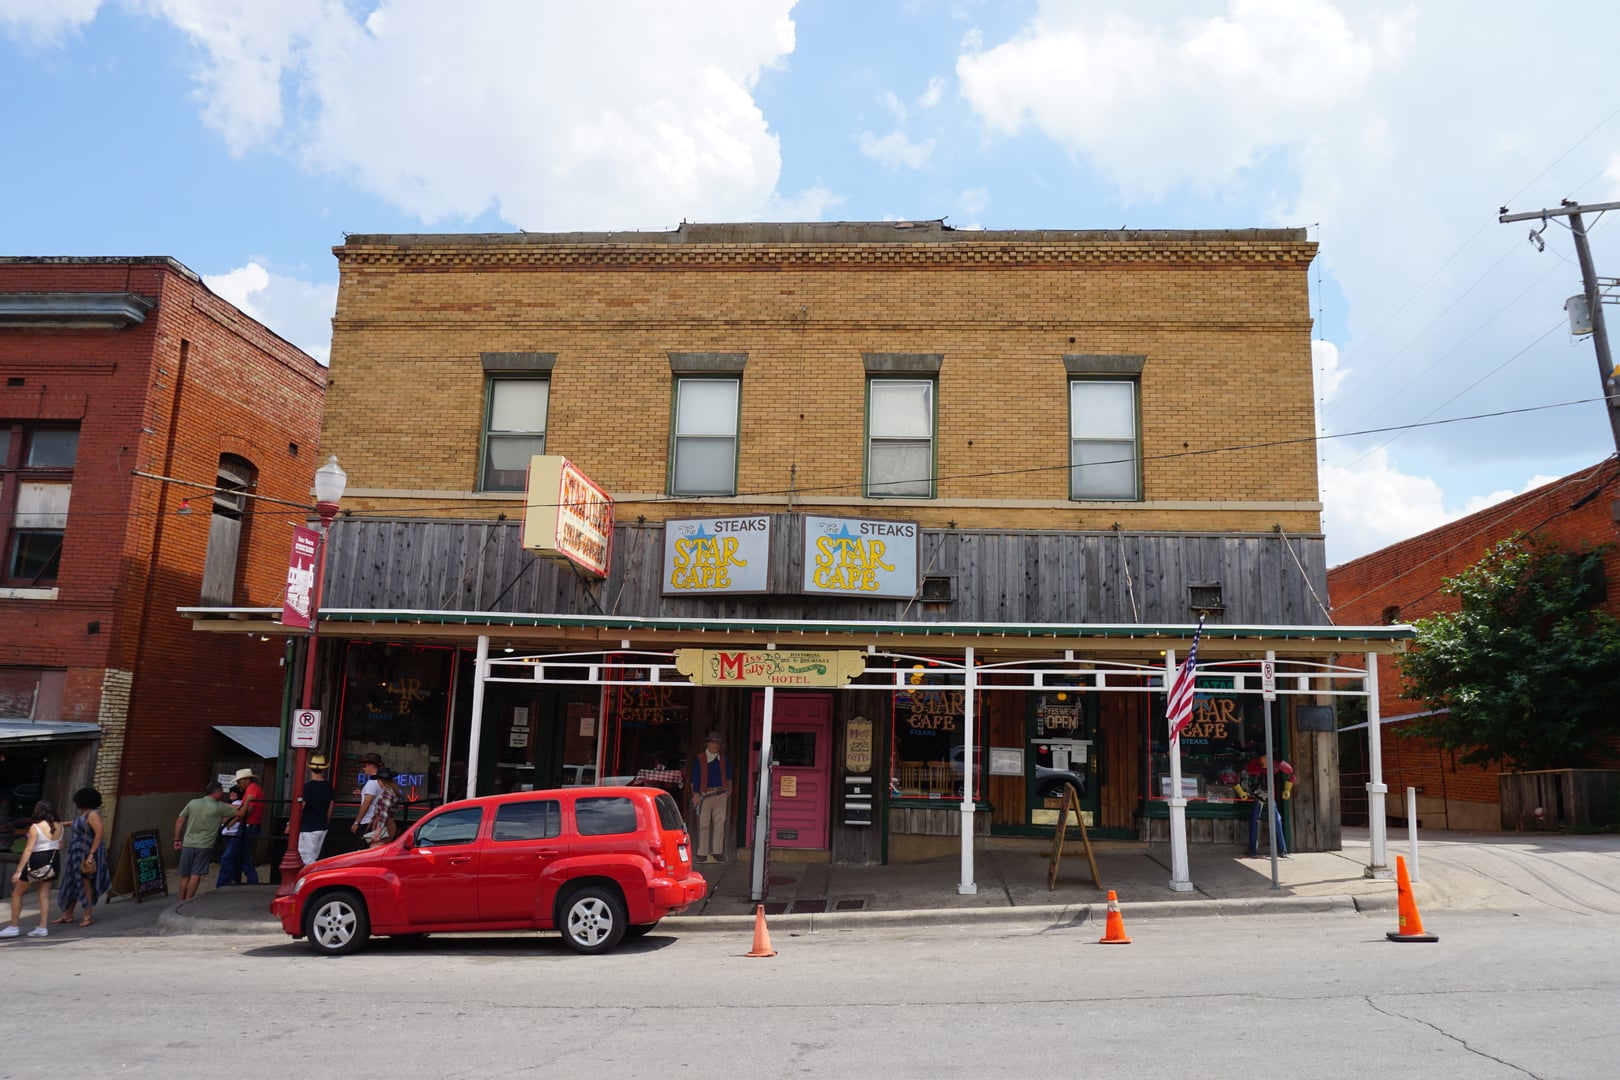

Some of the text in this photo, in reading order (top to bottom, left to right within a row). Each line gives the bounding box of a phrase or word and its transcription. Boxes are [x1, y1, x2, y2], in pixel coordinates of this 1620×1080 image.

[679, 525, 696, 535] The
[714, 519, 766, 533] STEAKS
[819, 522, 839, 533] The
[860, 522, 914, 537] STEAKS
[673, 536, 747, 567] STAR
[815, 536, 896, 572] STAR
[671, 566, 731, 589] CAFE
[813, 566, 880, 591] CAFE
[771, 675, 810, 684] HOTEL
[912, 691, 965, 715] STAR
[1192, 697, 1242, 723] TAR
[908, 714, 955, 730] CAFE
[1047, 715, 1077, 730] OPEN
